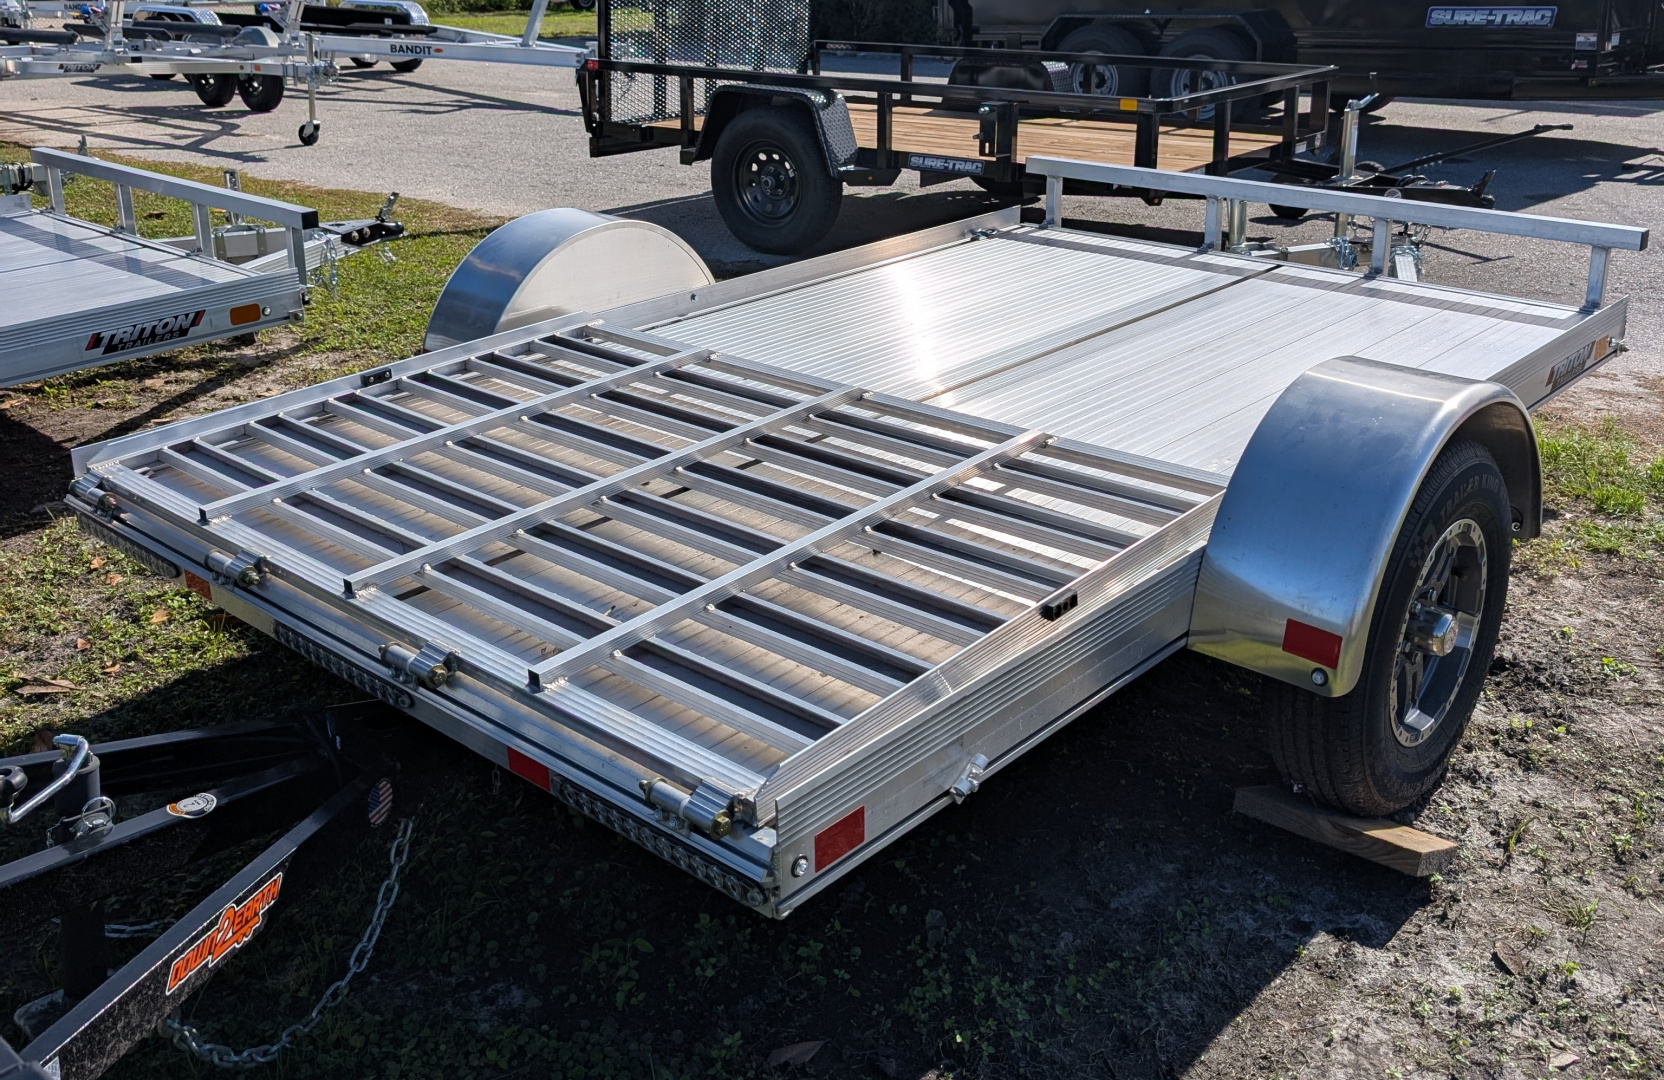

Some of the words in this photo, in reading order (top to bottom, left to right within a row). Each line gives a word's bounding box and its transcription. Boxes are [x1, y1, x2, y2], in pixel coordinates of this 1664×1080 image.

[1430, 9, 1552, 25] SURE-TRAC
[390, 44, 432, 55] BANDIT
[63, 63, 97, 71] TRITON
[910, 156, 983, 173] SURE-TRAC
[100, 311, 196, 348] TRITON
[118, 331, 180, 351] TRAILERS
[1552, 342, 1593, 383] TRITON
[1481, 474, 1500, 493] KING
